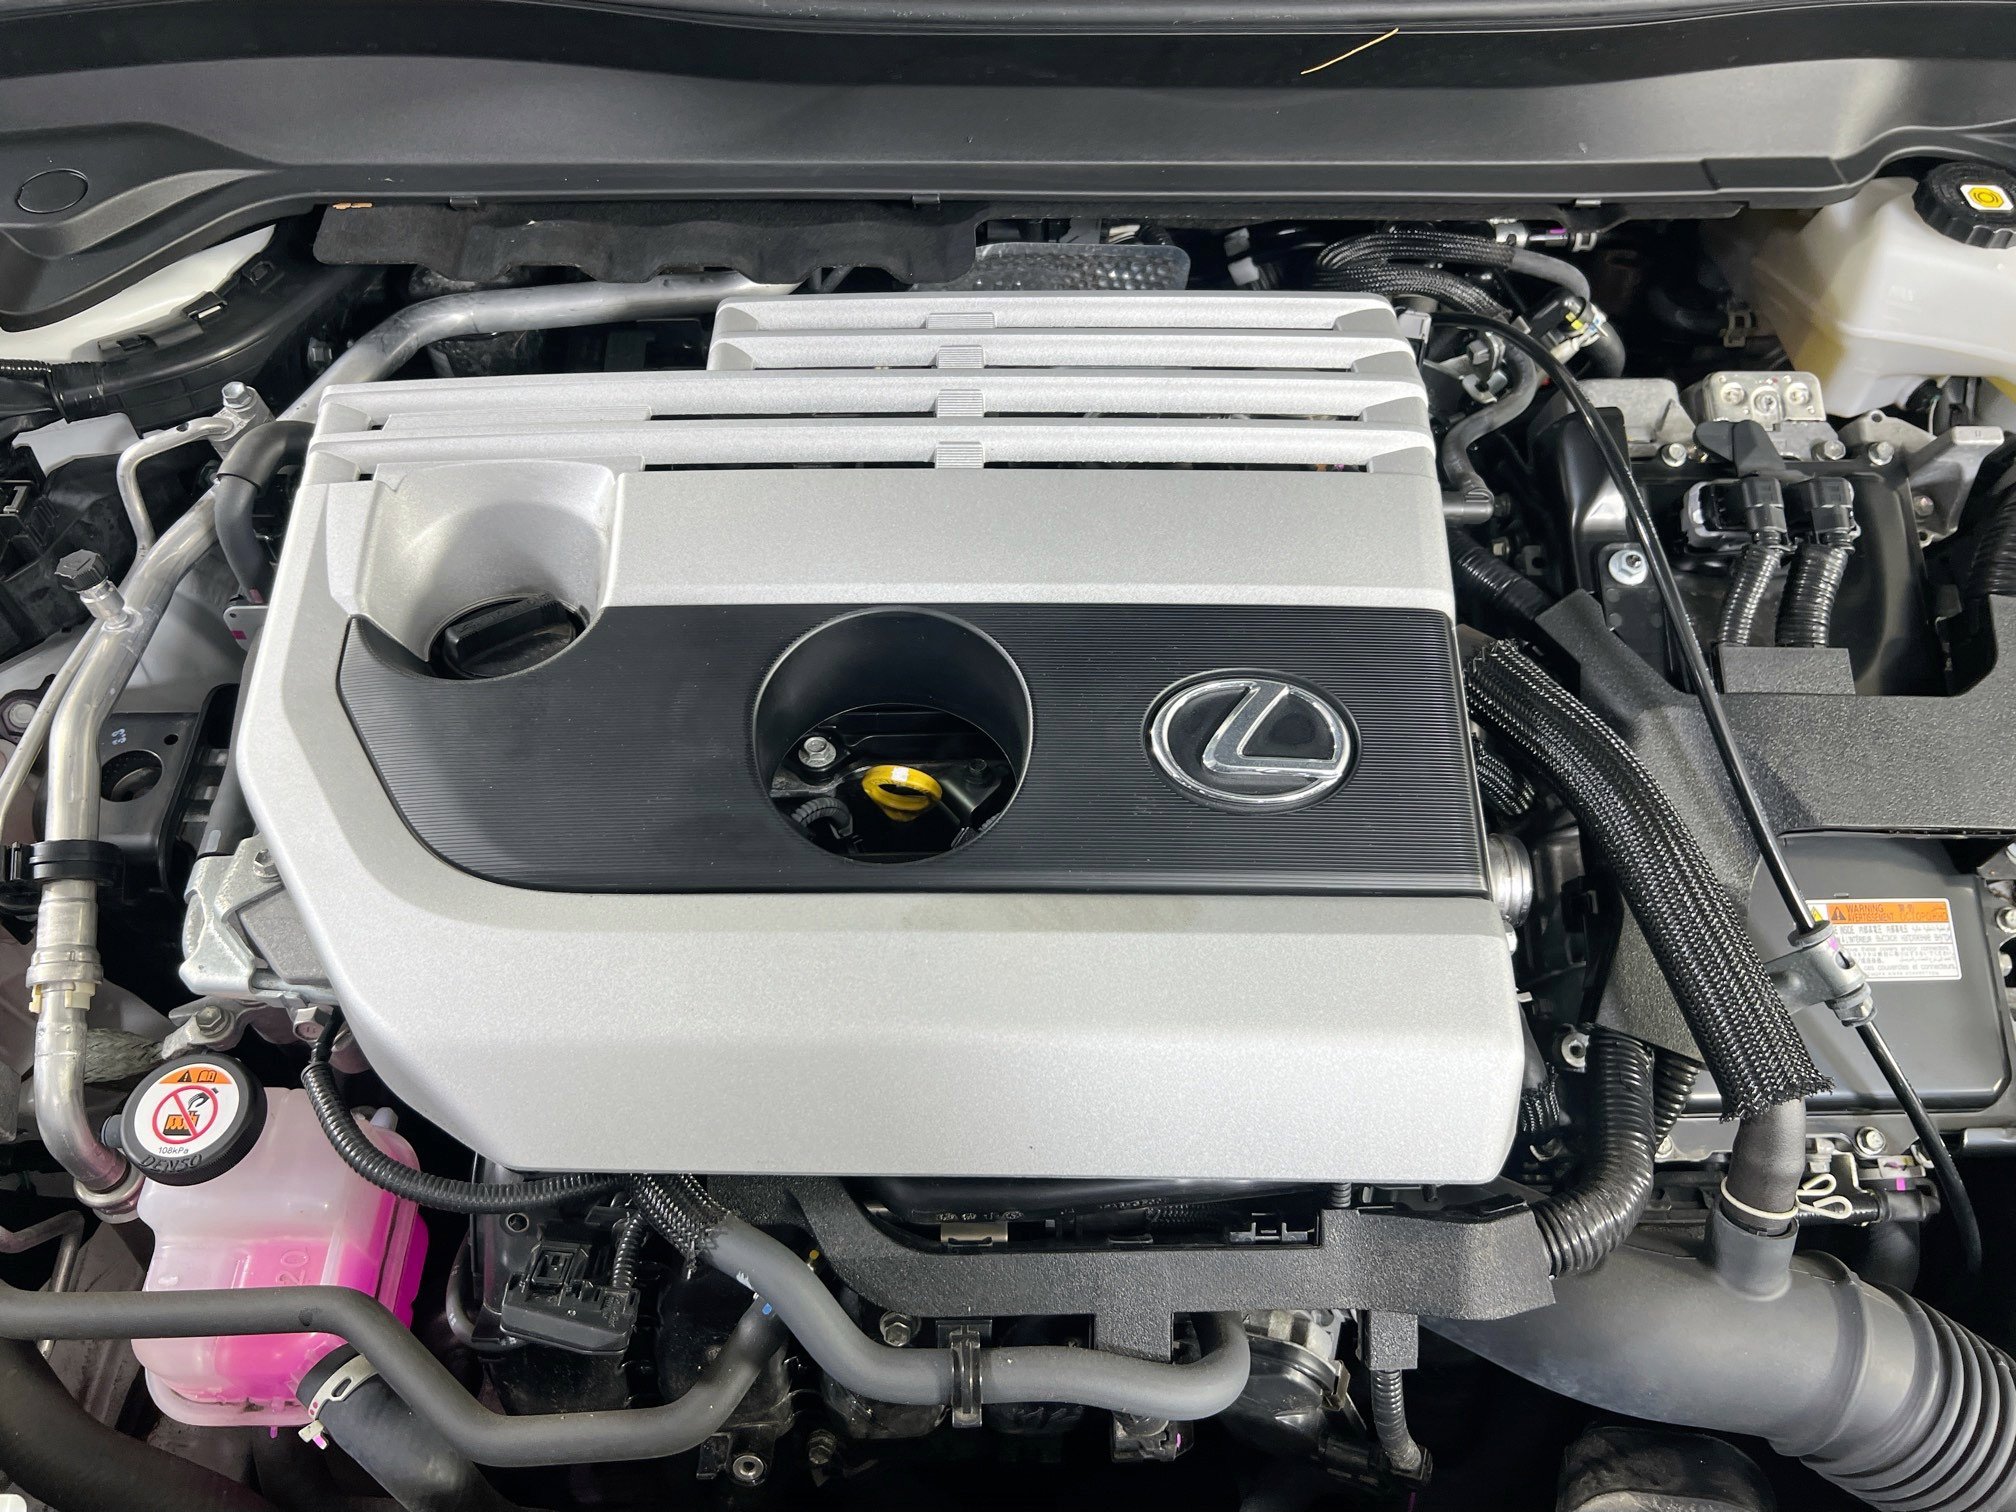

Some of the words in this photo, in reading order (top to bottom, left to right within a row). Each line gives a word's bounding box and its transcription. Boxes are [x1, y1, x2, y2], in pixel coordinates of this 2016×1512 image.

[1846, 904, 1884, 913] WARNING
[1847, 913, 1894, 922] AVERTISSEMENT
[158, 1146, 189, 1154] 108kPa
[138, 1154, 202, 1172] DENSO
